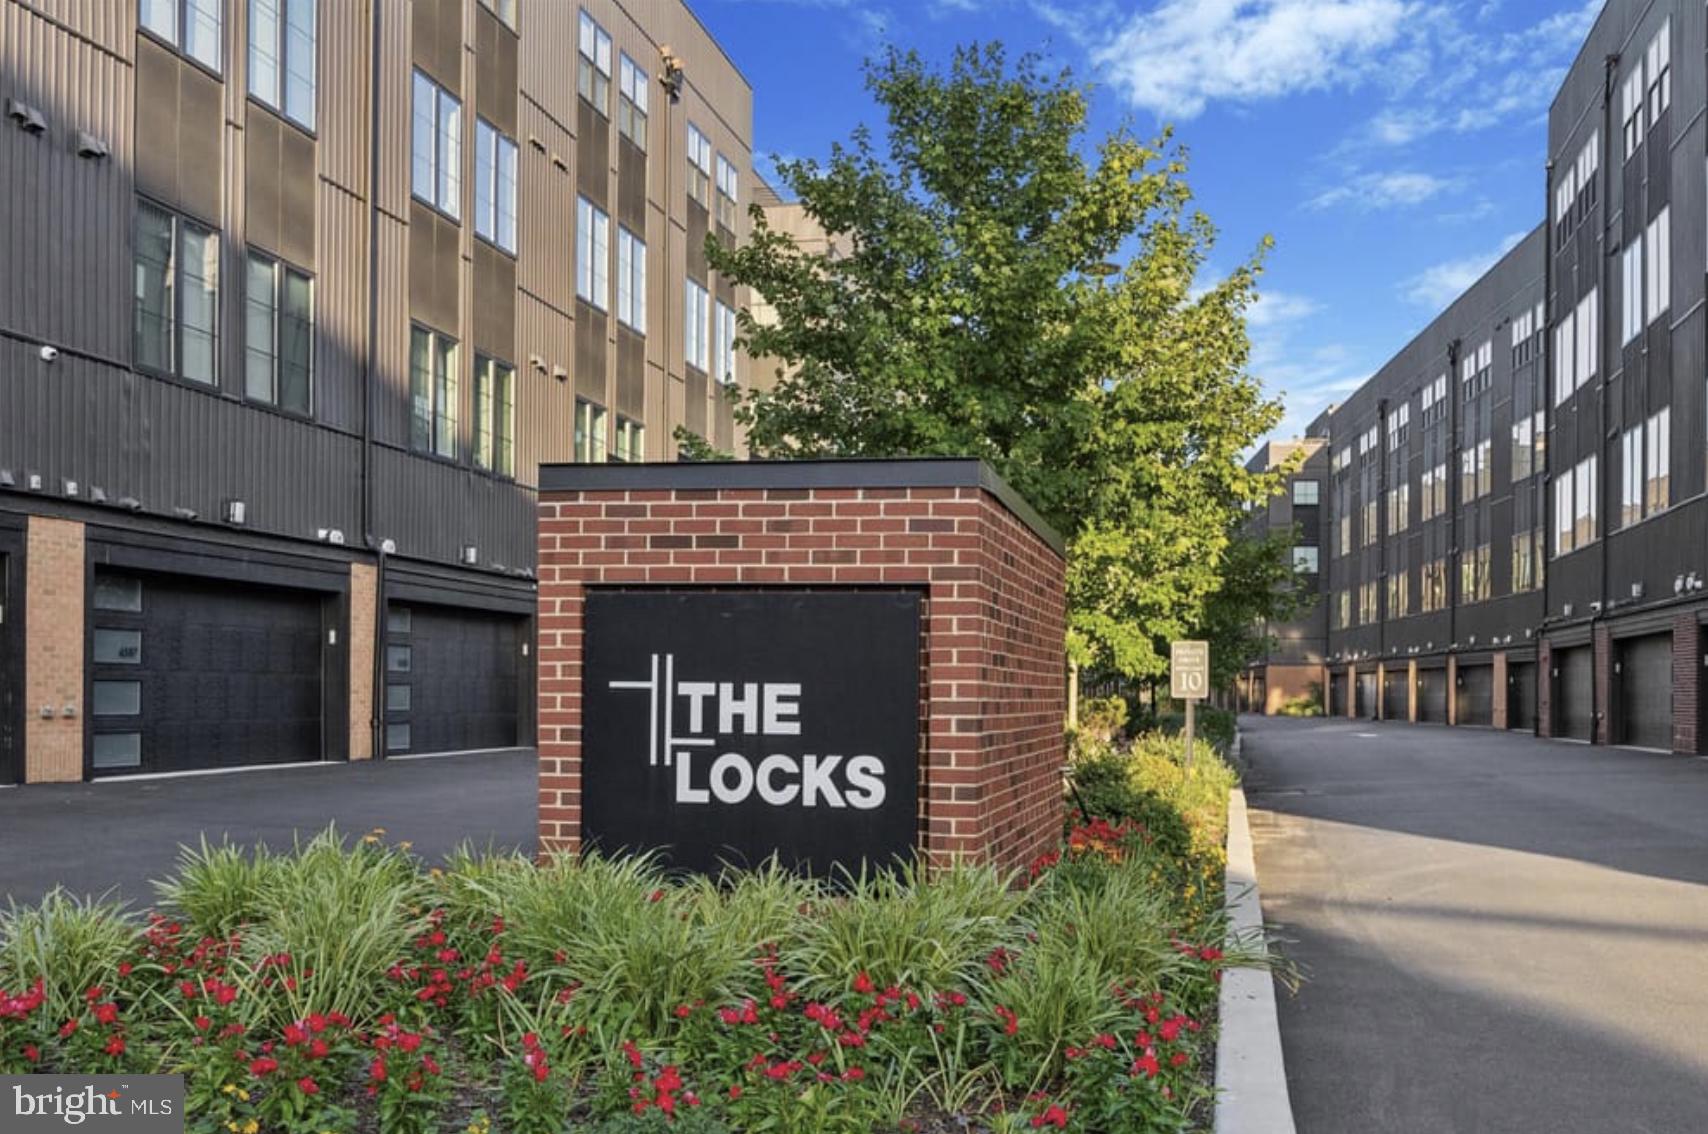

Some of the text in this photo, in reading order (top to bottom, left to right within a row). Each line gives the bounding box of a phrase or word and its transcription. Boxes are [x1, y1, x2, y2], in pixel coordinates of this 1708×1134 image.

[1181, 672, 1202, 691] 10
[678, 682, 801, 734] THE
[677, 752, 886, 808] LOCKS
